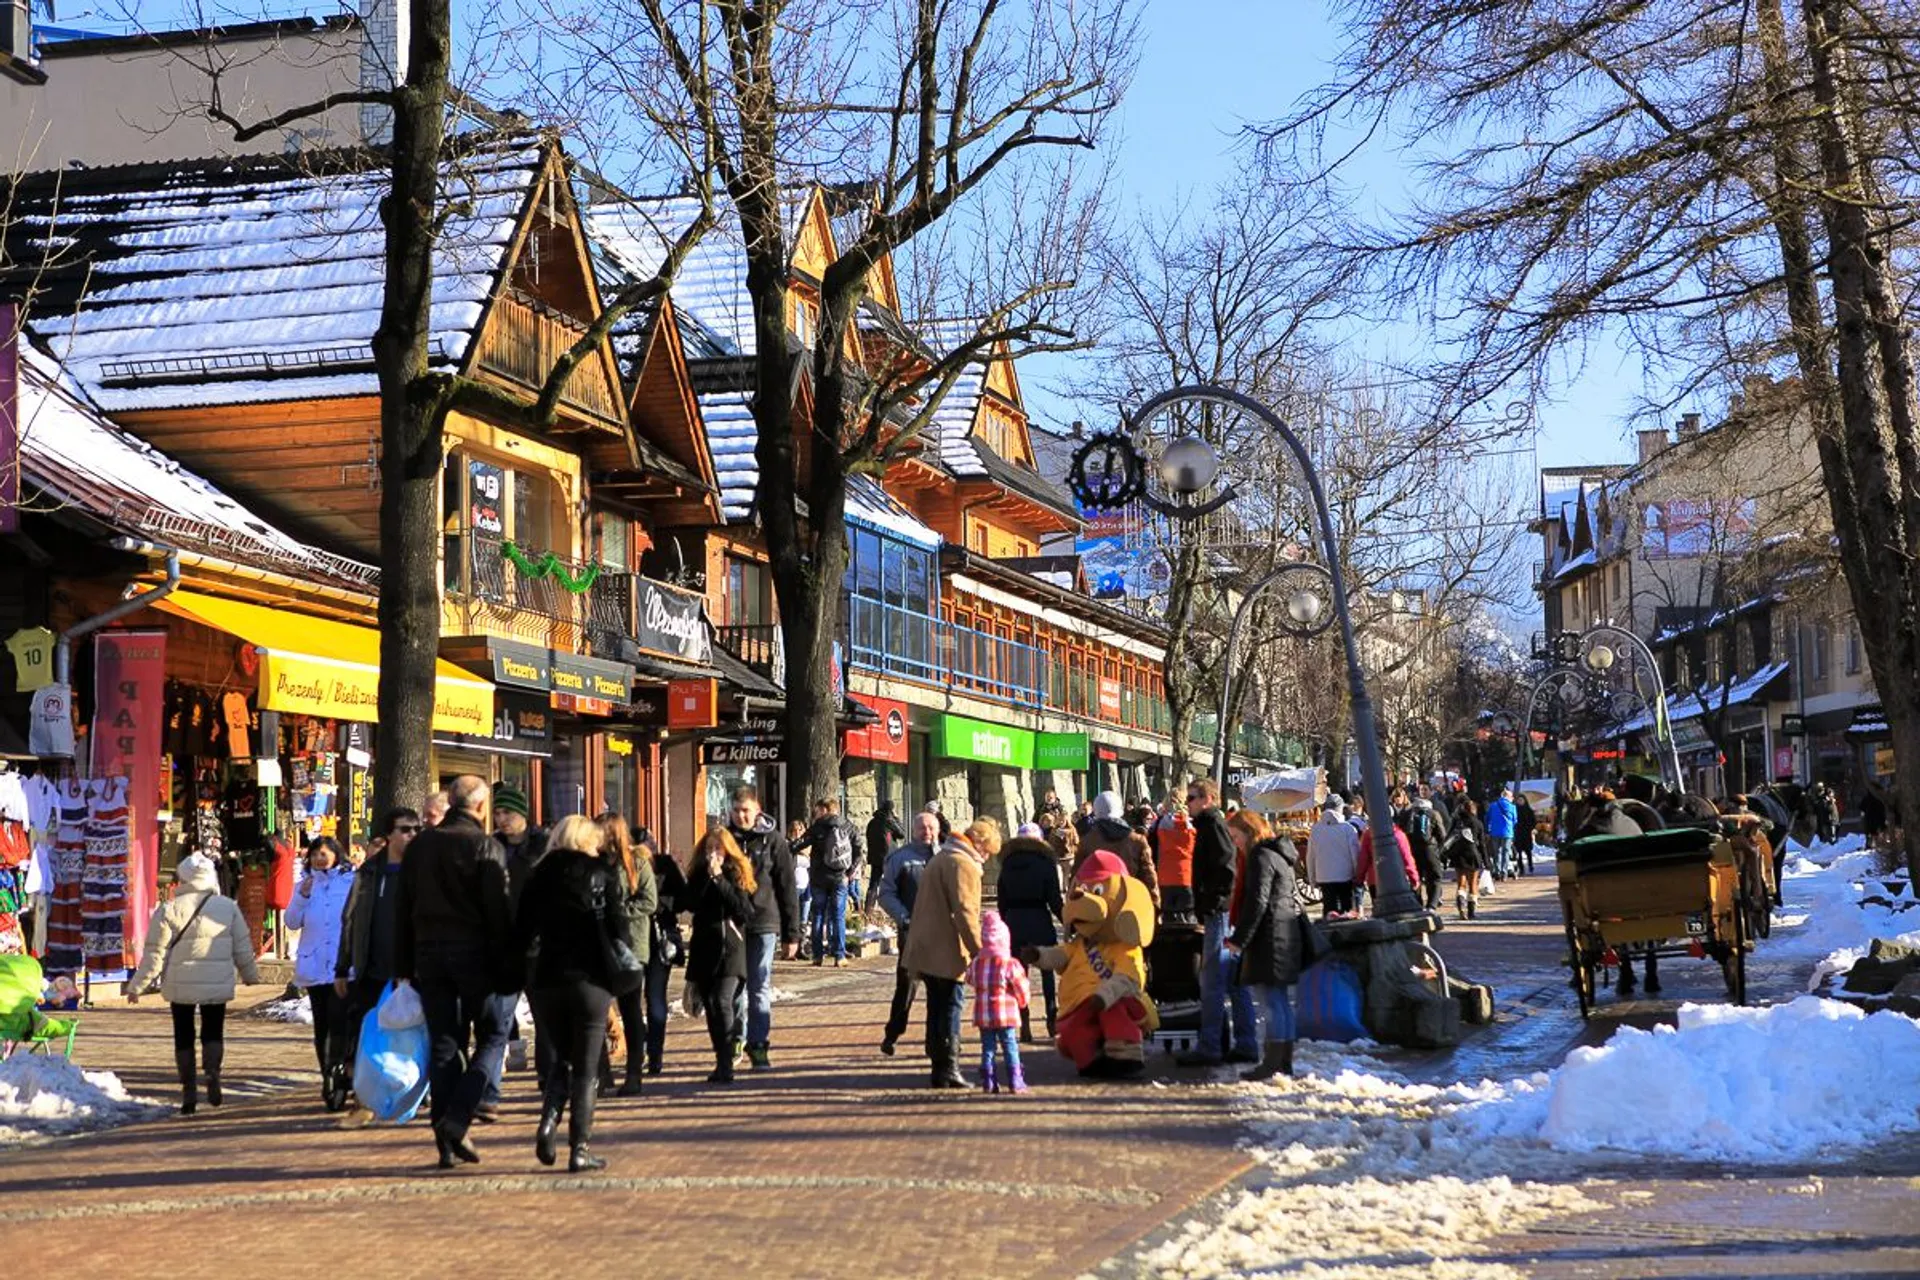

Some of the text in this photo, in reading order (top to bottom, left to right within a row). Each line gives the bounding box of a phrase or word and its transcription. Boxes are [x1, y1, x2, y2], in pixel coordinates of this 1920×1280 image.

[24, 648, 42, 666] 10
[277, 673, 323, 706] Prezenty
[502, 657, 626, 698] Pizzeria Pizzeria Pizzeria
[729, 745, 779, 761] killtec
[972, 728, 1011, 761] natura
[1039, 741, 1084, 758] natura
